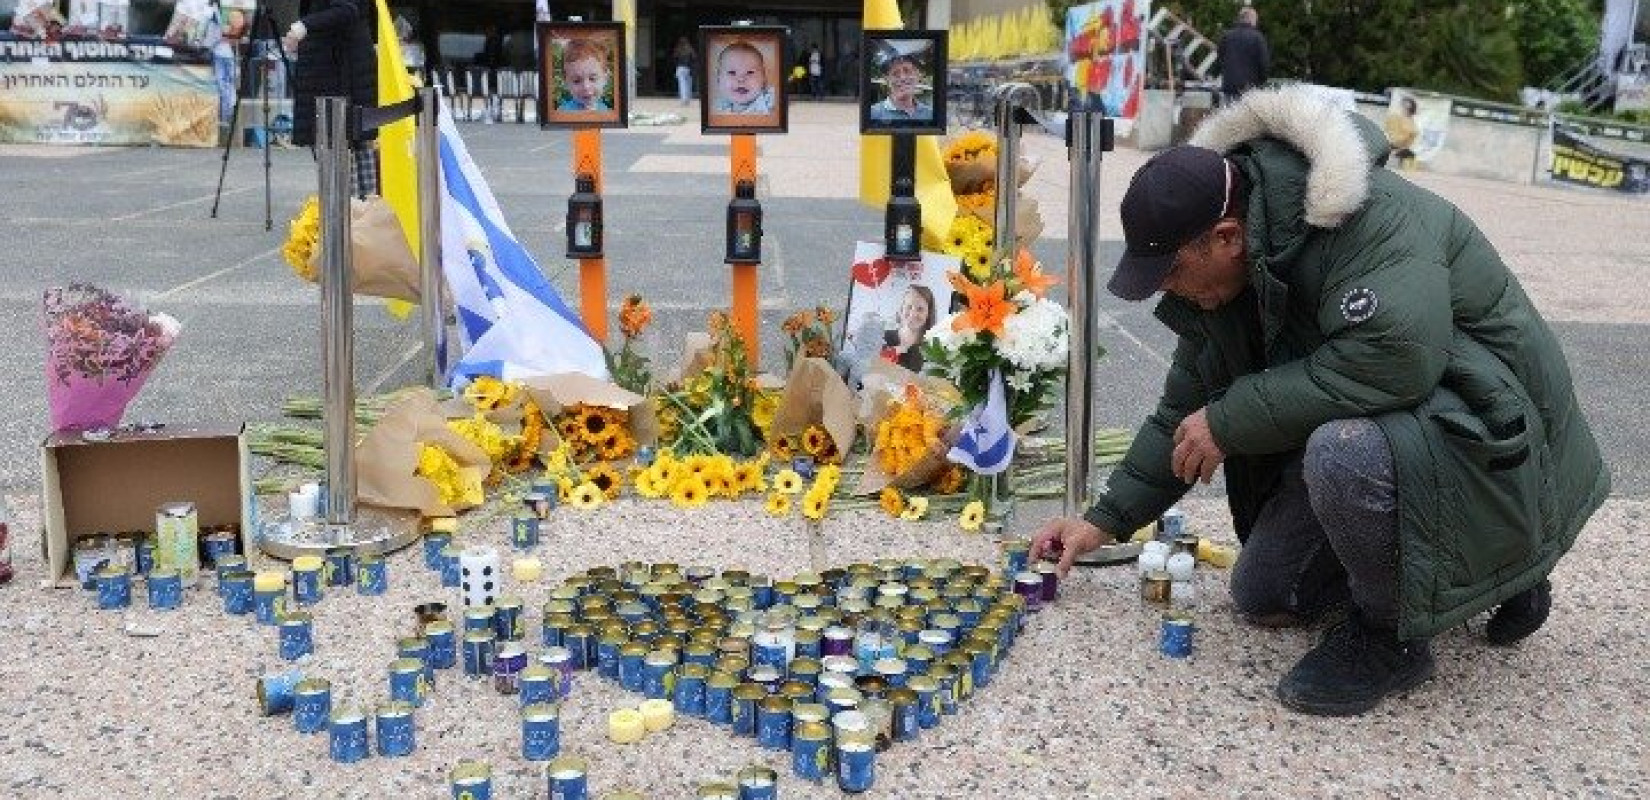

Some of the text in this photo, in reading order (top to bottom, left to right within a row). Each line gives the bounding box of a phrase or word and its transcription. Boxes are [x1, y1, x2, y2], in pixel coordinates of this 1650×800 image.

[4, 72, 150, 90] עד התלם האחרון
